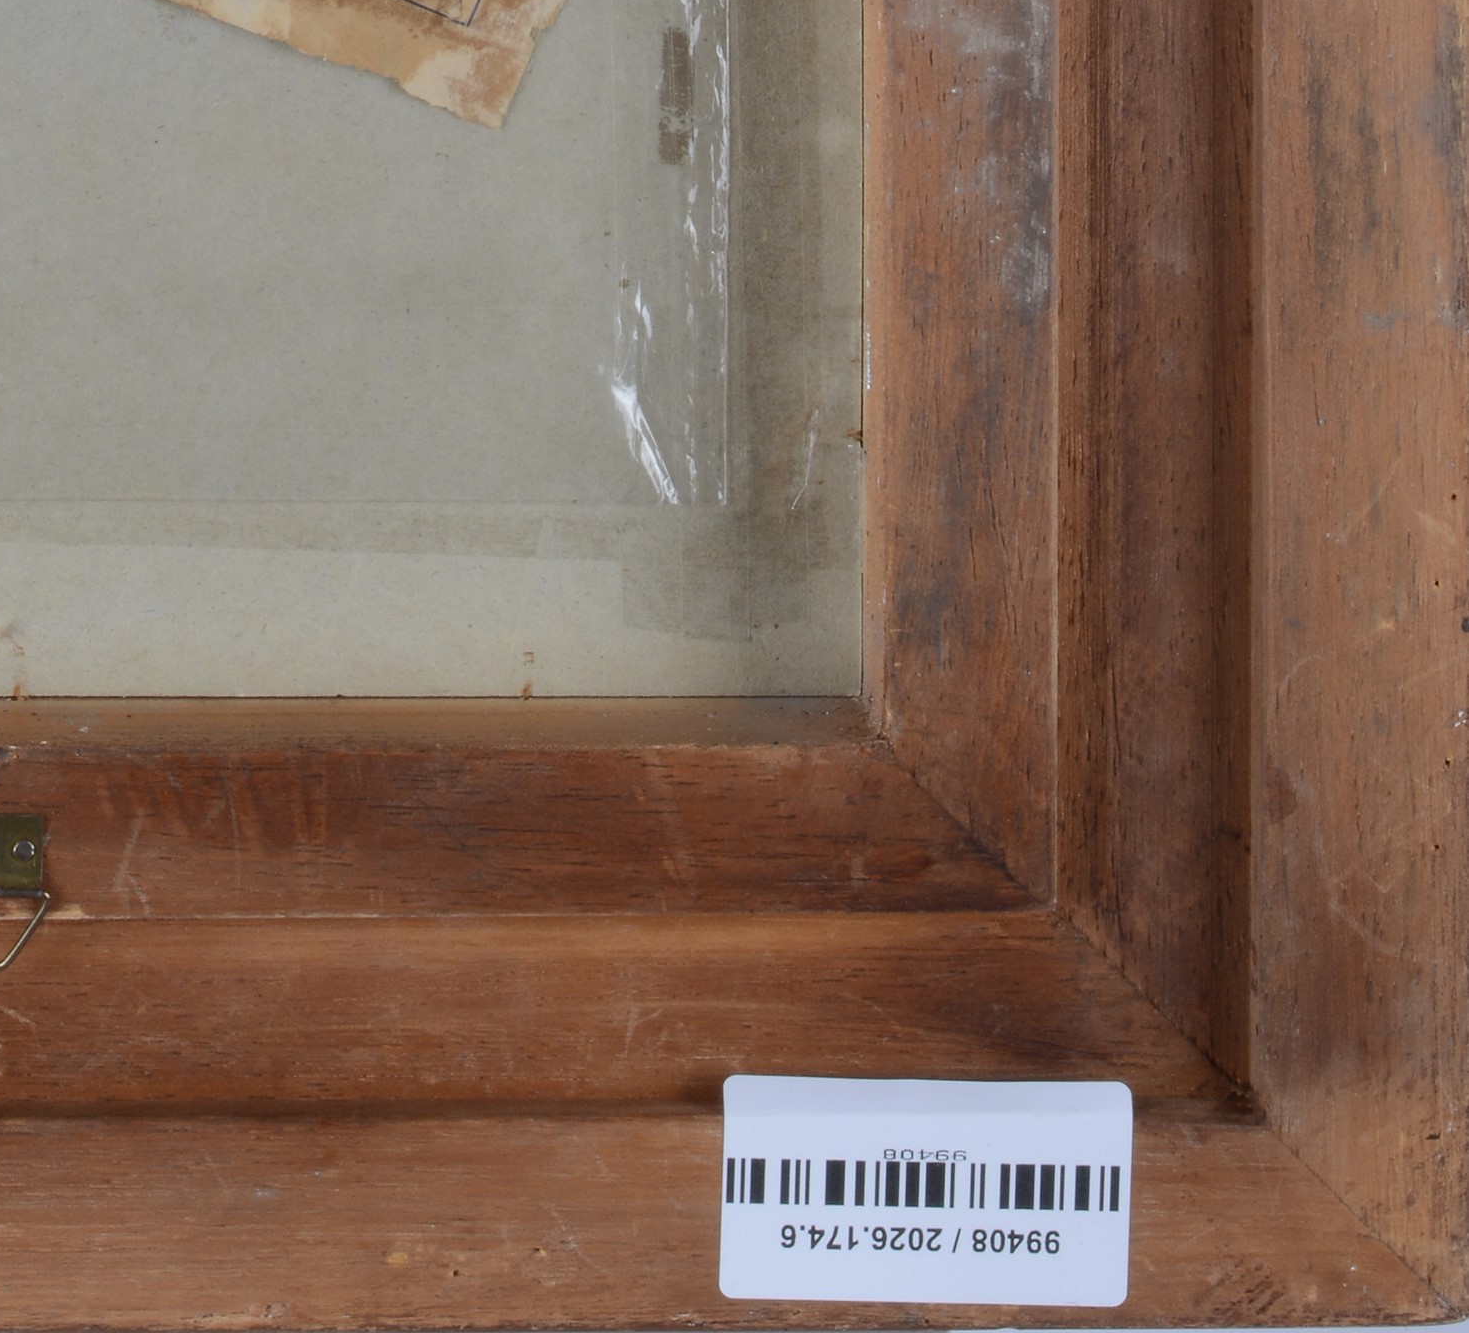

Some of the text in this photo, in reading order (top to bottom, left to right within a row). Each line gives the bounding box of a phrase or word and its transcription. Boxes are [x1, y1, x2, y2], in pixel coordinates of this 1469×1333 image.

[882, 1148, 968, 1162] 99408
[780, 1224, 943, 1252] 2026.174.6
[972, 1229, 1061, 1255] 99408
